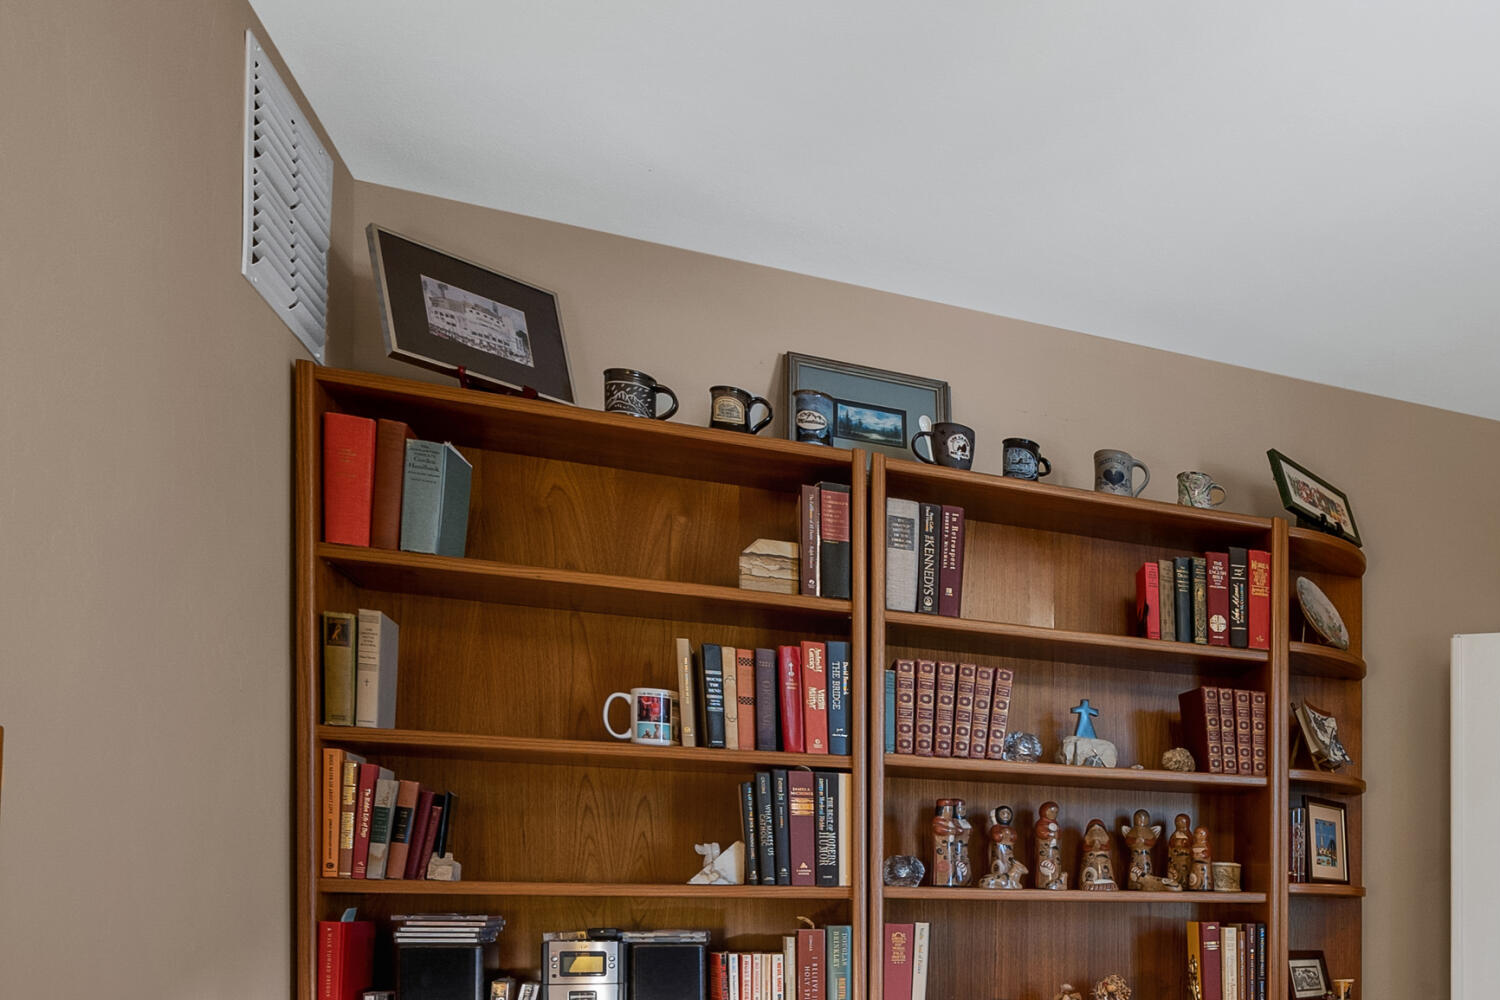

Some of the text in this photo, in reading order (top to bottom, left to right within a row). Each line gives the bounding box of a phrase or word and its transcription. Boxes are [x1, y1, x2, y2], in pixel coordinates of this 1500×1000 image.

[948, 513, 959, 570] In Retrospect
[923, 540, 935, 595] KENNEDYS
[831, 661, 841, 710] THE BRIDGE
[363, 788, 371, 797] The
[360, 826, 370, 838] Dogs
[361, 813, 370, 822] Life
[760, 813, 768, 847] CATHOLIC
[765, 804, 774, 856] WHAT MAKES US
[818, 832, 829, 866] HUMOR
[827, 832, 836, 866] MODERN
[832, 931, 840, 968] BRINKLEY
[803, 966, 811, 986] HOLY
[811, 963, 819, 993] BELIEVE
